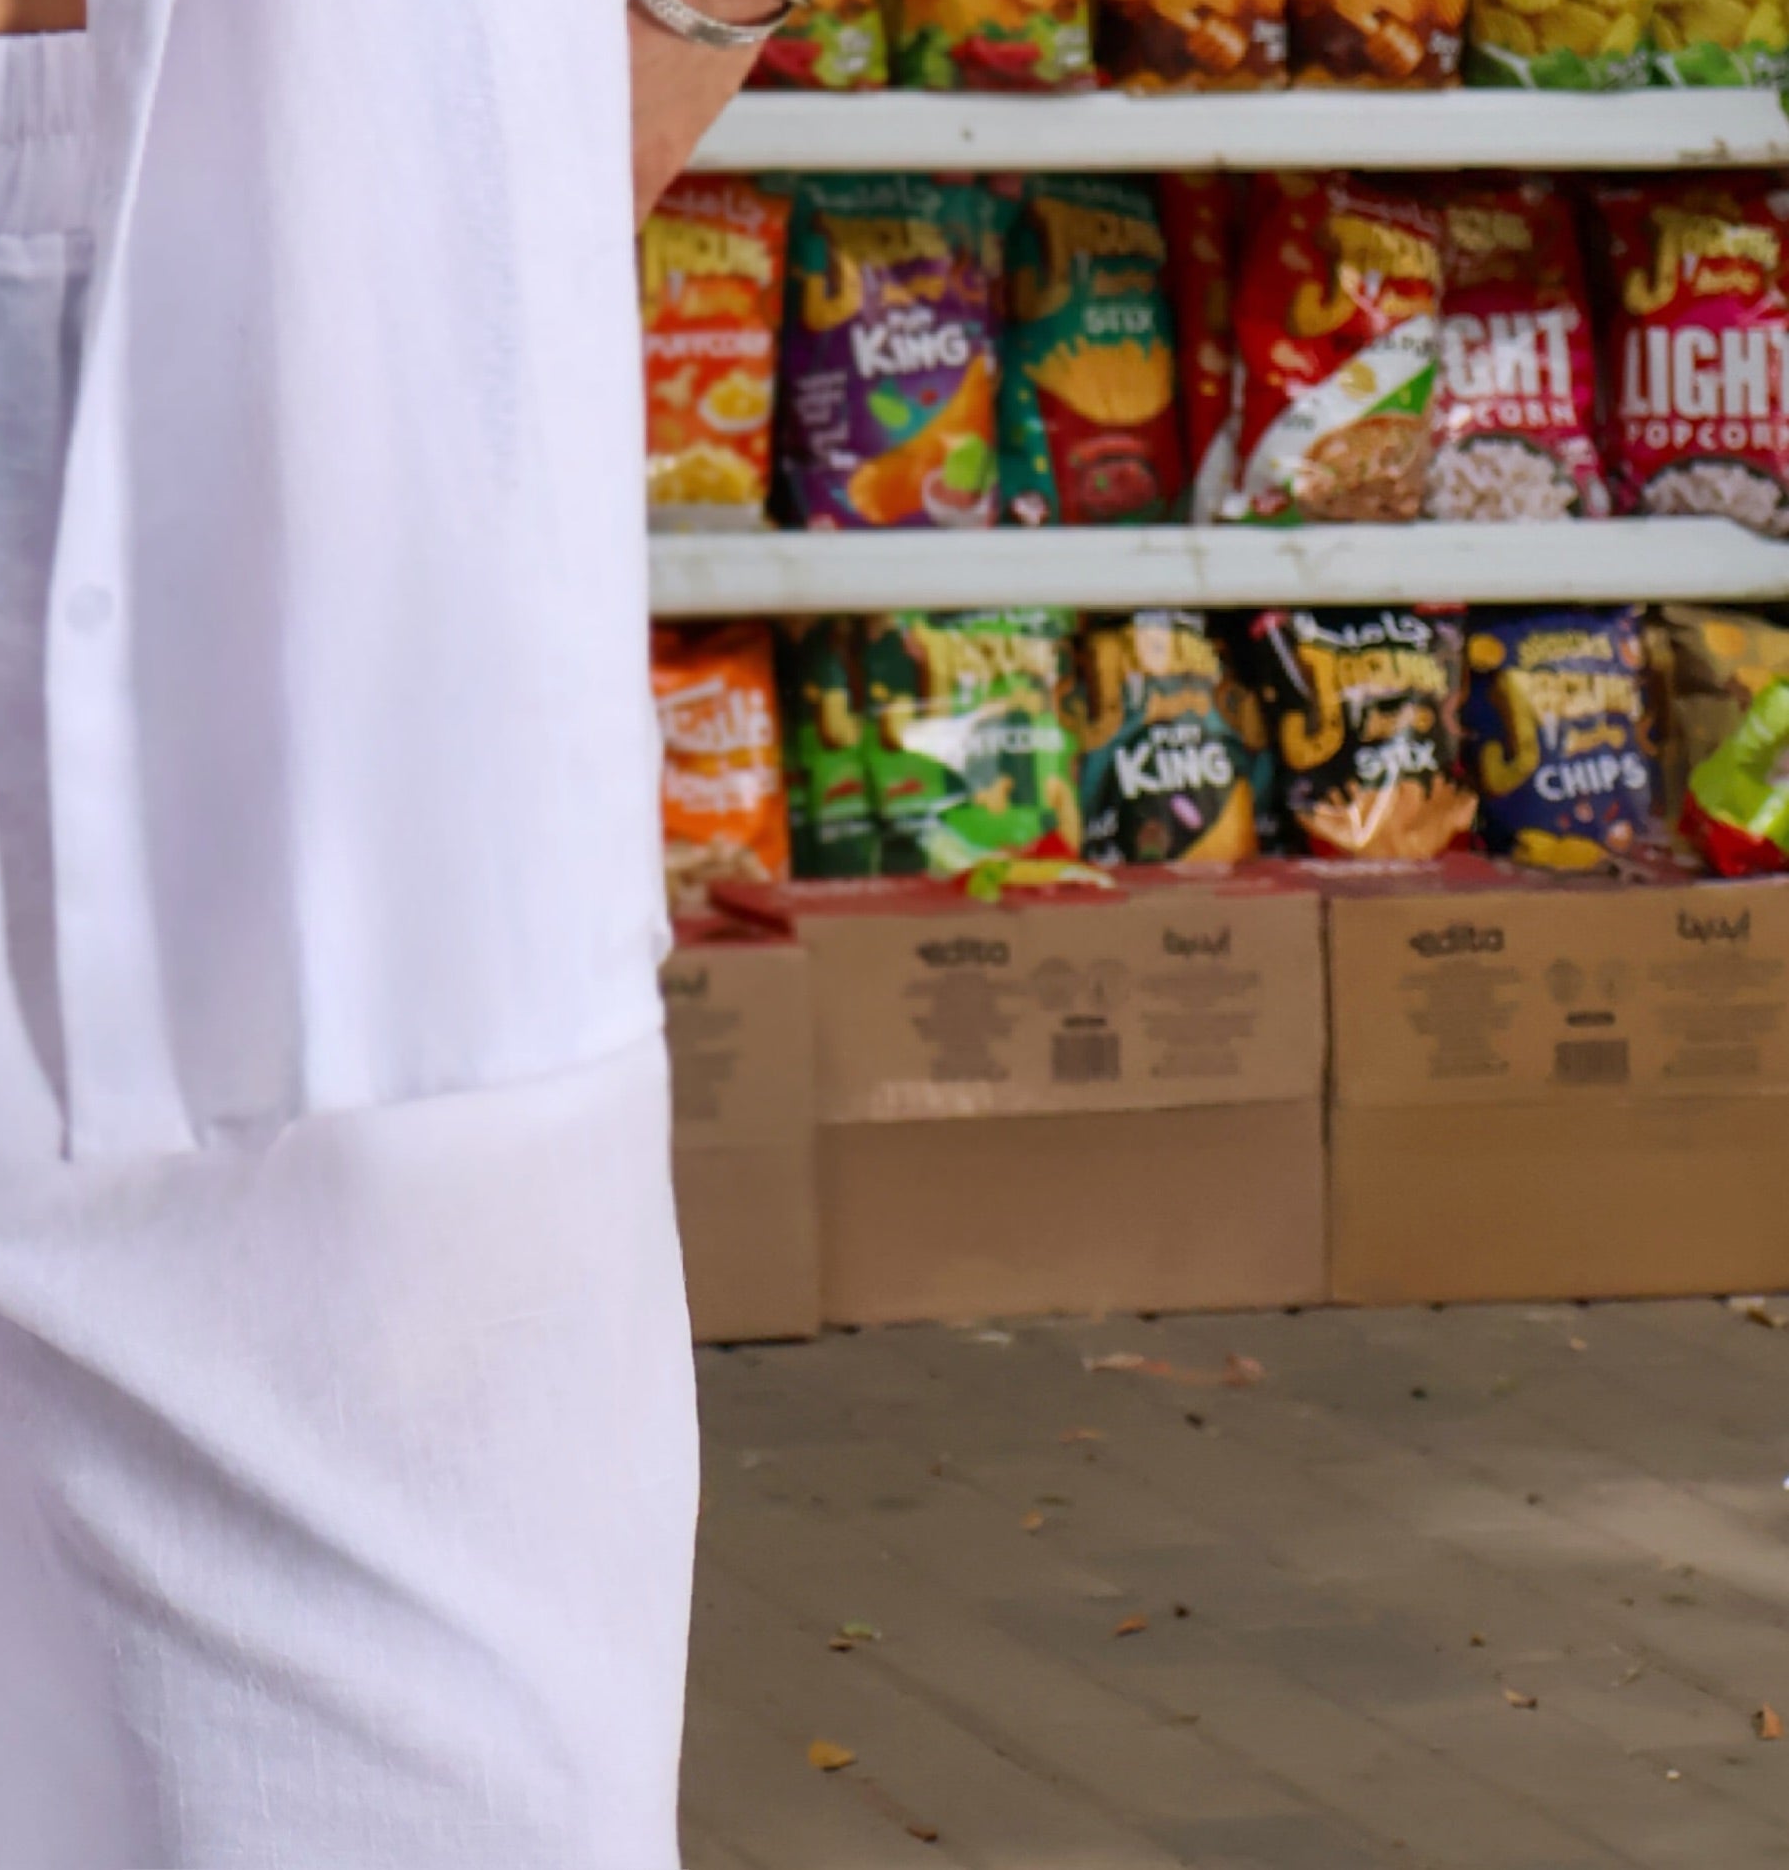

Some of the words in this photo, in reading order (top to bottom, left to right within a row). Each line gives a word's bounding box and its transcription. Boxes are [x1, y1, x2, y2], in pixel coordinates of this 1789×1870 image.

[851, 323, 969, 378] KING
[1443, 312, 1580, 399] GHT
[1114, 741, 1235, 799] KING
[1533, 755, 1648, 802] CHIPS
